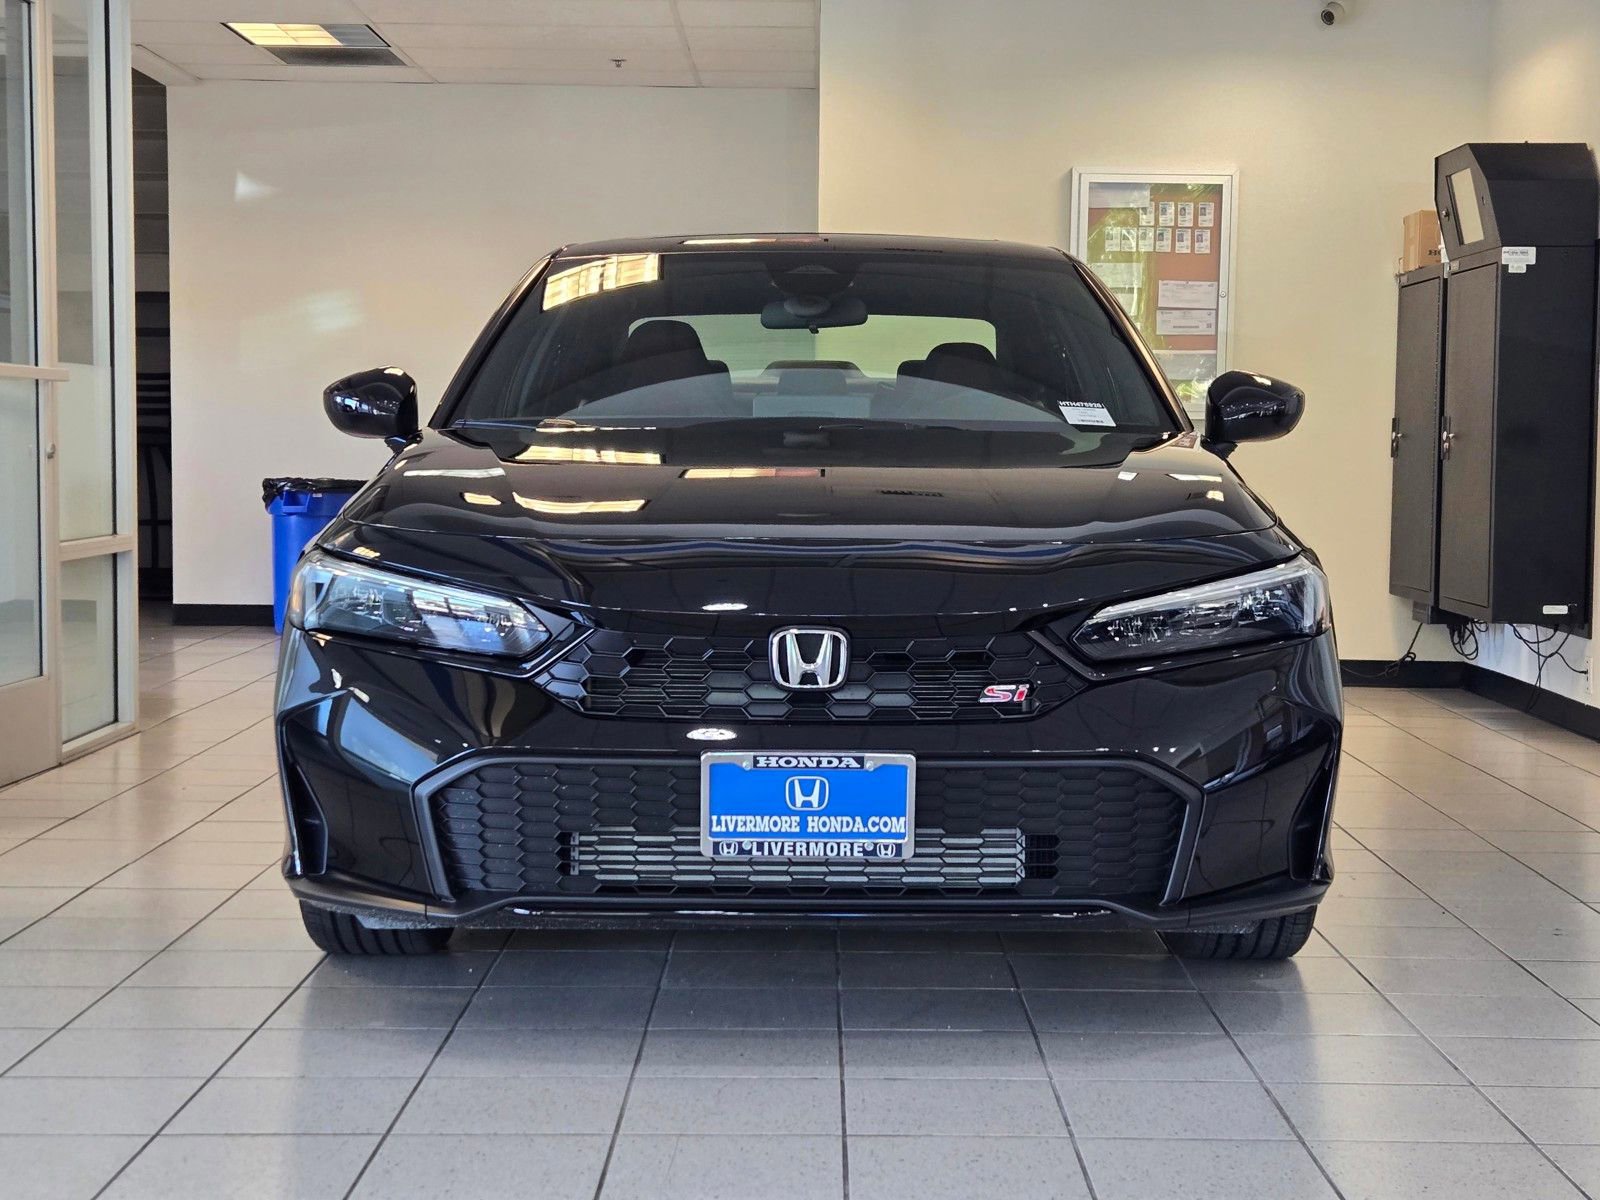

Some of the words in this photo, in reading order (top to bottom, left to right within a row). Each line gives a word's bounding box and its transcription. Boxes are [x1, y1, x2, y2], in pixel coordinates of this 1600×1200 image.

[980, 684, 1030, 703] Si
[755, 756, 861, 768] HONDA
[711, 815, 800, 833] LIVERMORE
[806, 815, 906, 833] HONDA.COM
[751, 841, 865, 857] LIVERMORE
